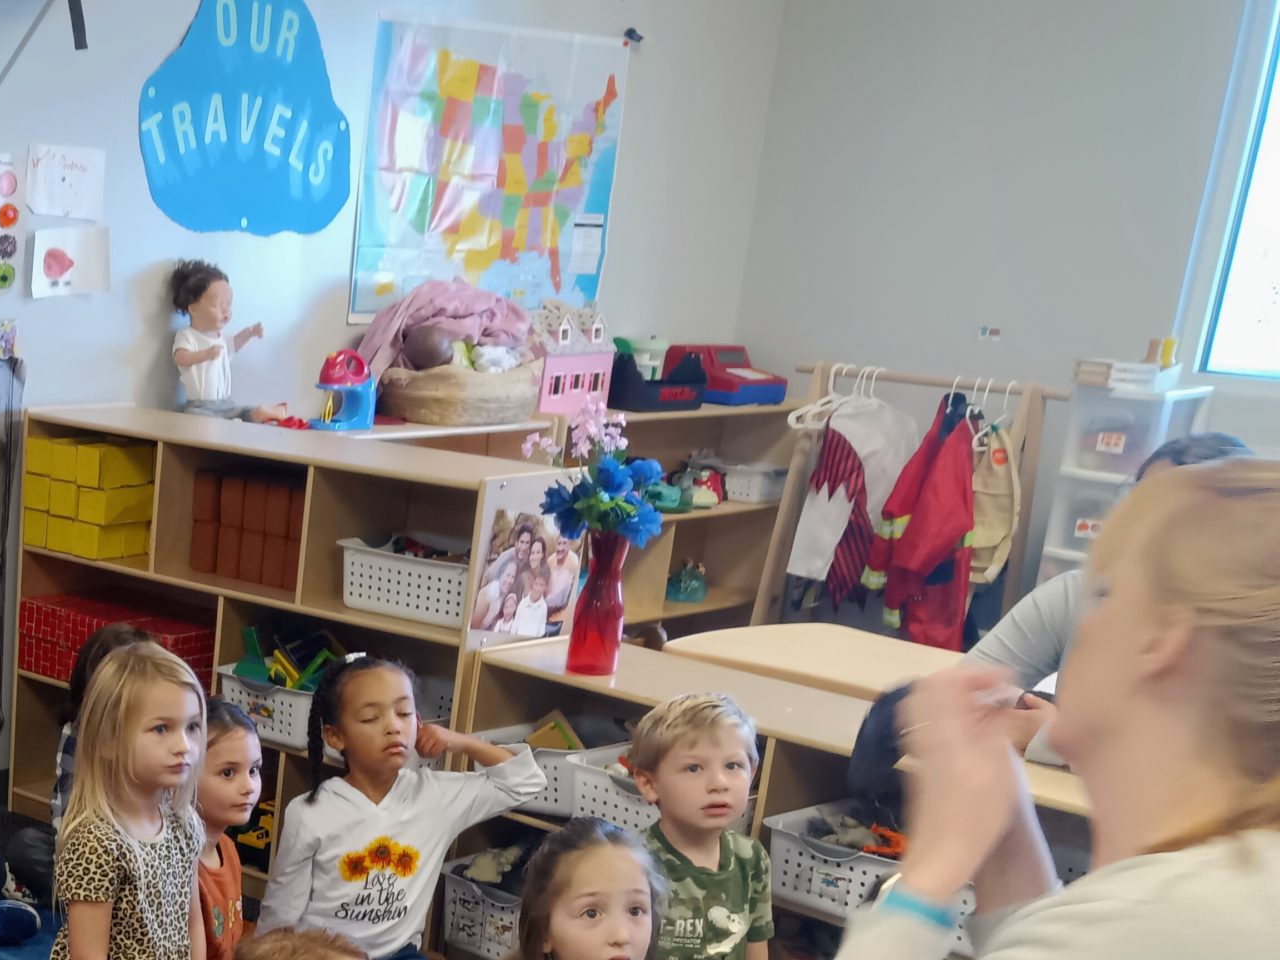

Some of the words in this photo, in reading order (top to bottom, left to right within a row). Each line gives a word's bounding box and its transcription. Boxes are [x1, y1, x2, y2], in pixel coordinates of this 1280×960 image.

[216, 0, 299, 62] OUR
[141, 93, 333, 185] TRAVELS
[354, 892, 374, 906] in
[376, 883, 406, 906] the
[659, 918, 703, 938] T-REX
